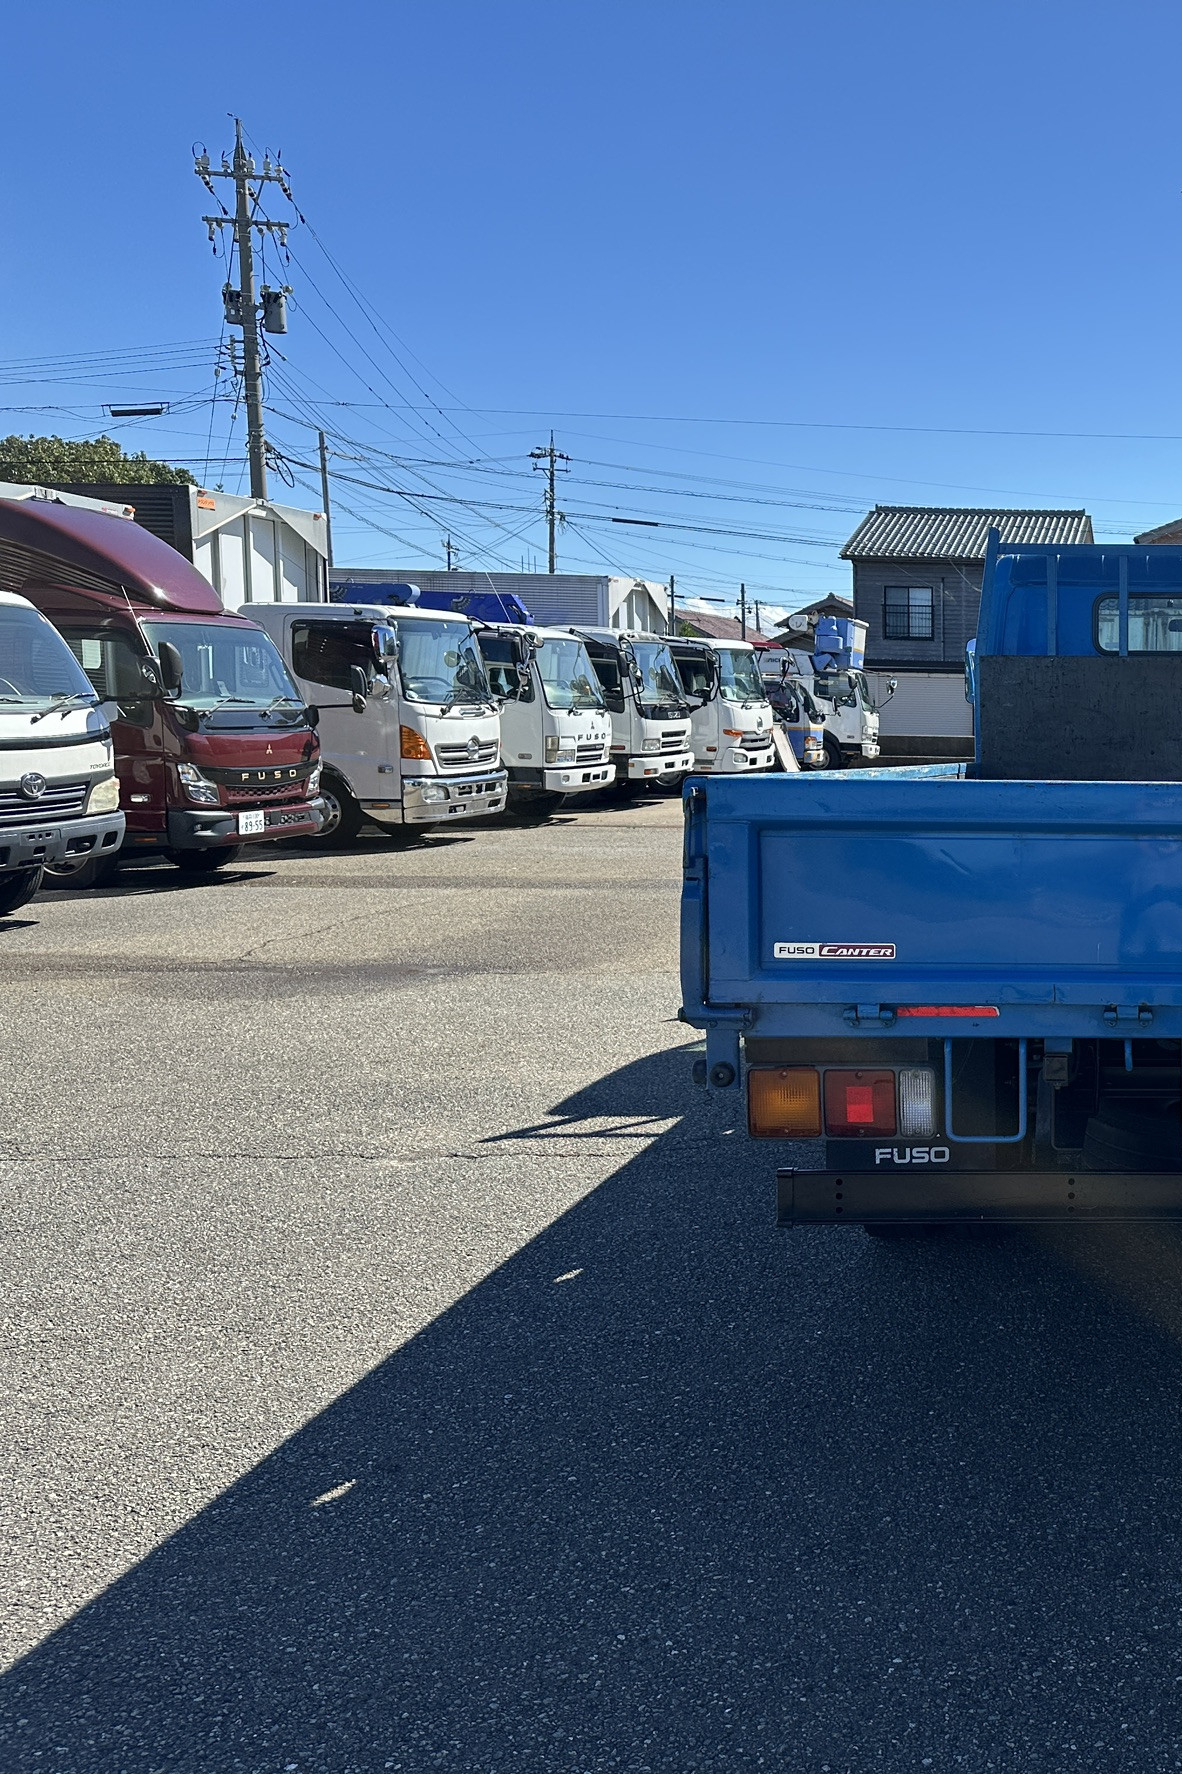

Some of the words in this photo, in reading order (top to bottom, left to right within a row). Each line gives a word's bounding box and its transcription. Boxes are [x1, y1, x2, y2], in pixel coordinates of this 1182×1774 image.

[577, 732, 606, 741] FUSO
[241, 769, 297, 782] FUSO
[778, 946, 815, 955] FUSO
[820, 946, 893, 956] CANTER
[875, 1146, 950, 1165] FUSO
